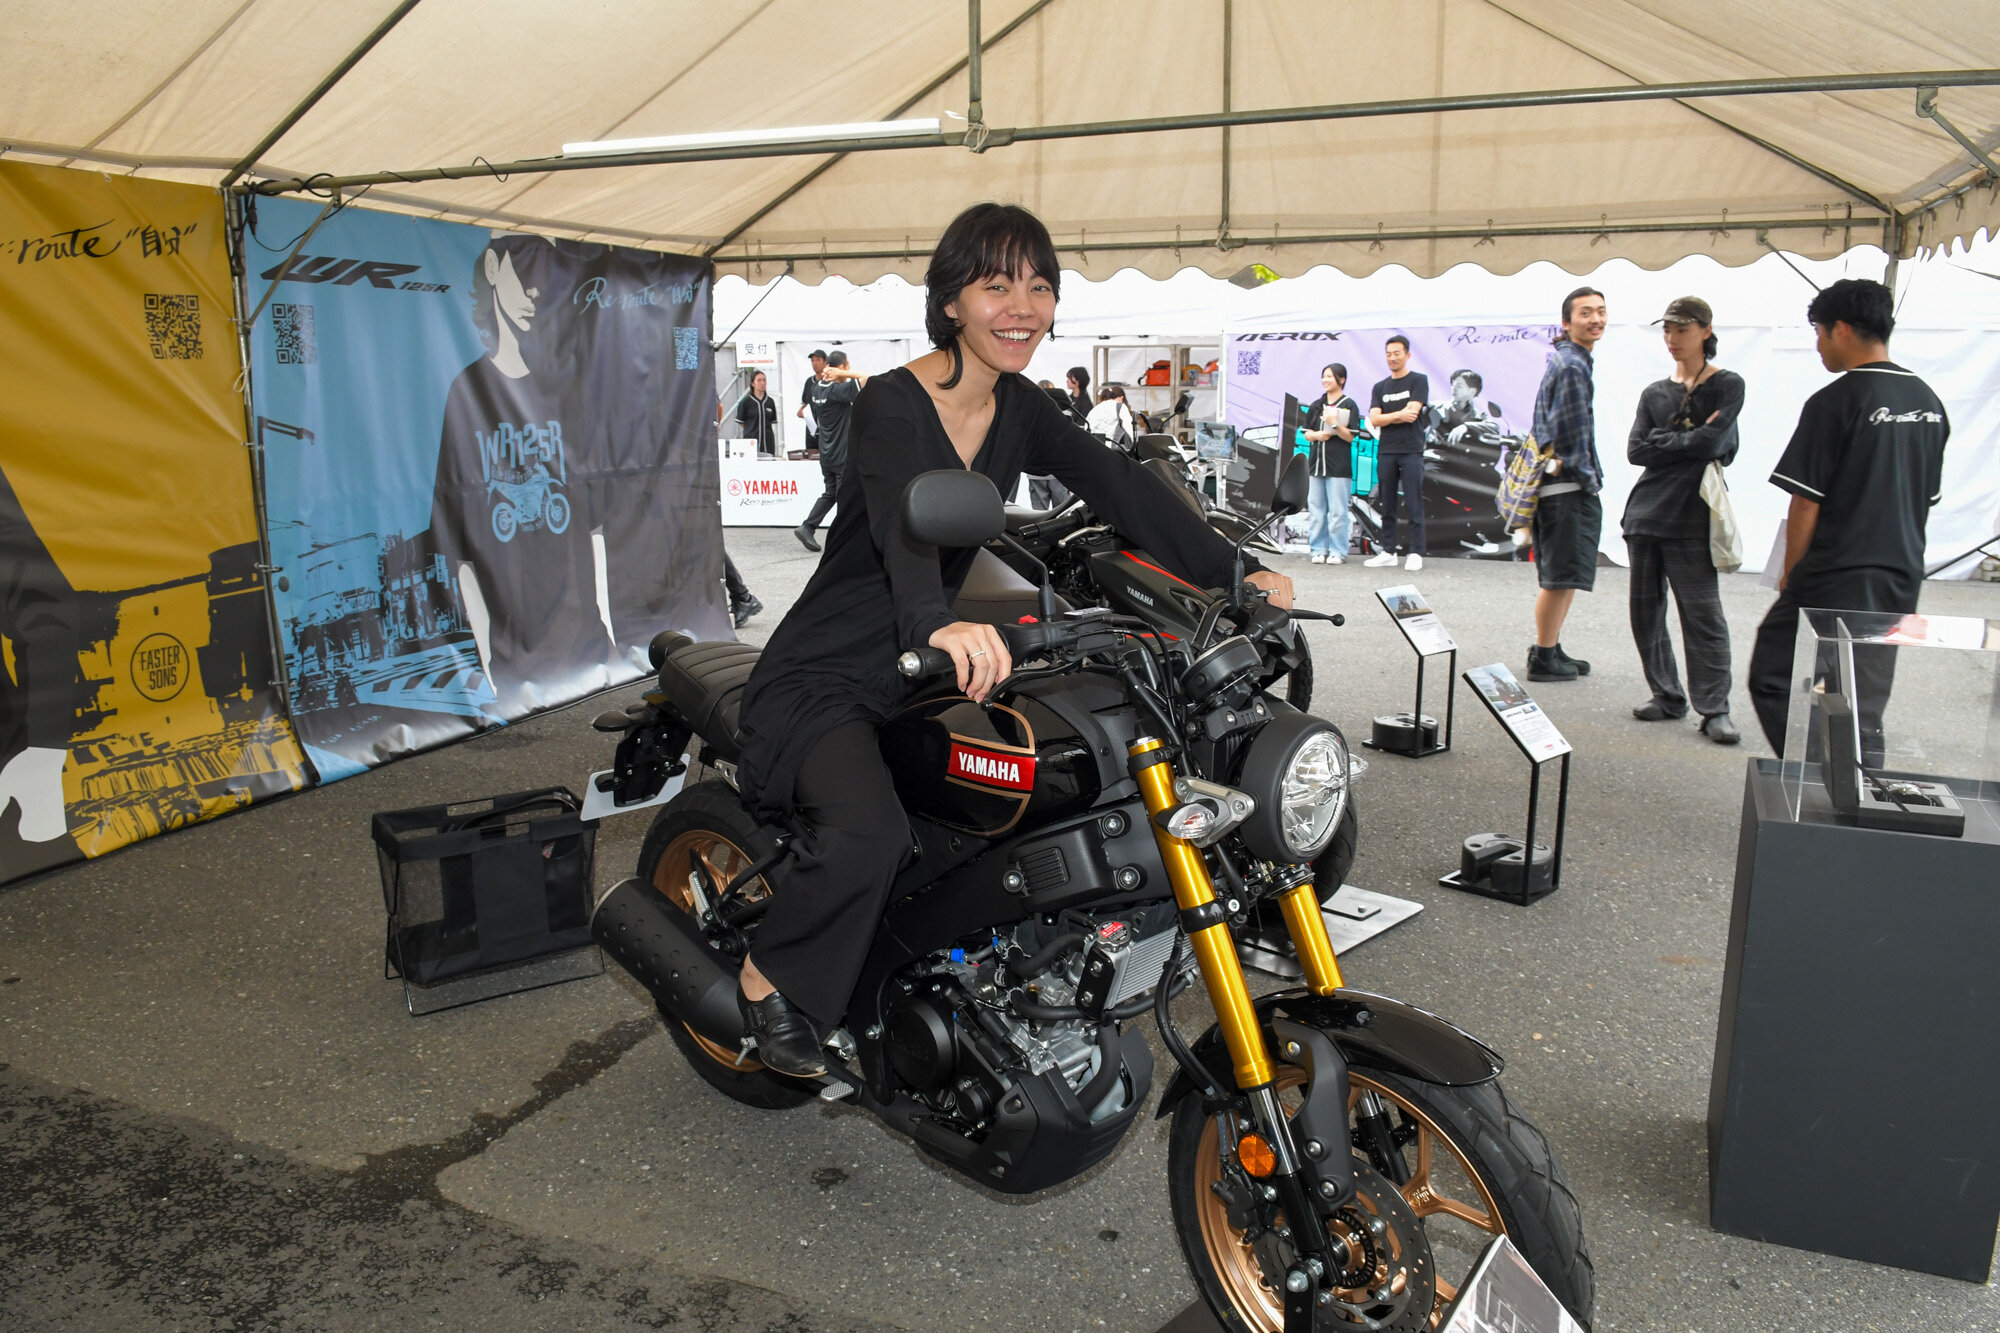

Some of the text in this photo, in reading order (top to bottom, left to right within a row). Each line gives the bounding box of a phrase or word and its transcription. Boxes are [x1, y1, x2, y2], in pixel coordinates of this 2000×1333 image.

[260, 254, 452, 294] WR 125R
[1235, 332, 1343, 342] AEROX
[475, 420, 567, 485] WR125R
[743, 480, 798, 495] YAMAHA
[1126, 585, 1154, 607] YAMAHA
[140, 645, 180, 671] FASTER
[149, 666, 177, 690] SONS
[958, 751, 1020, 783] YAMAHA
